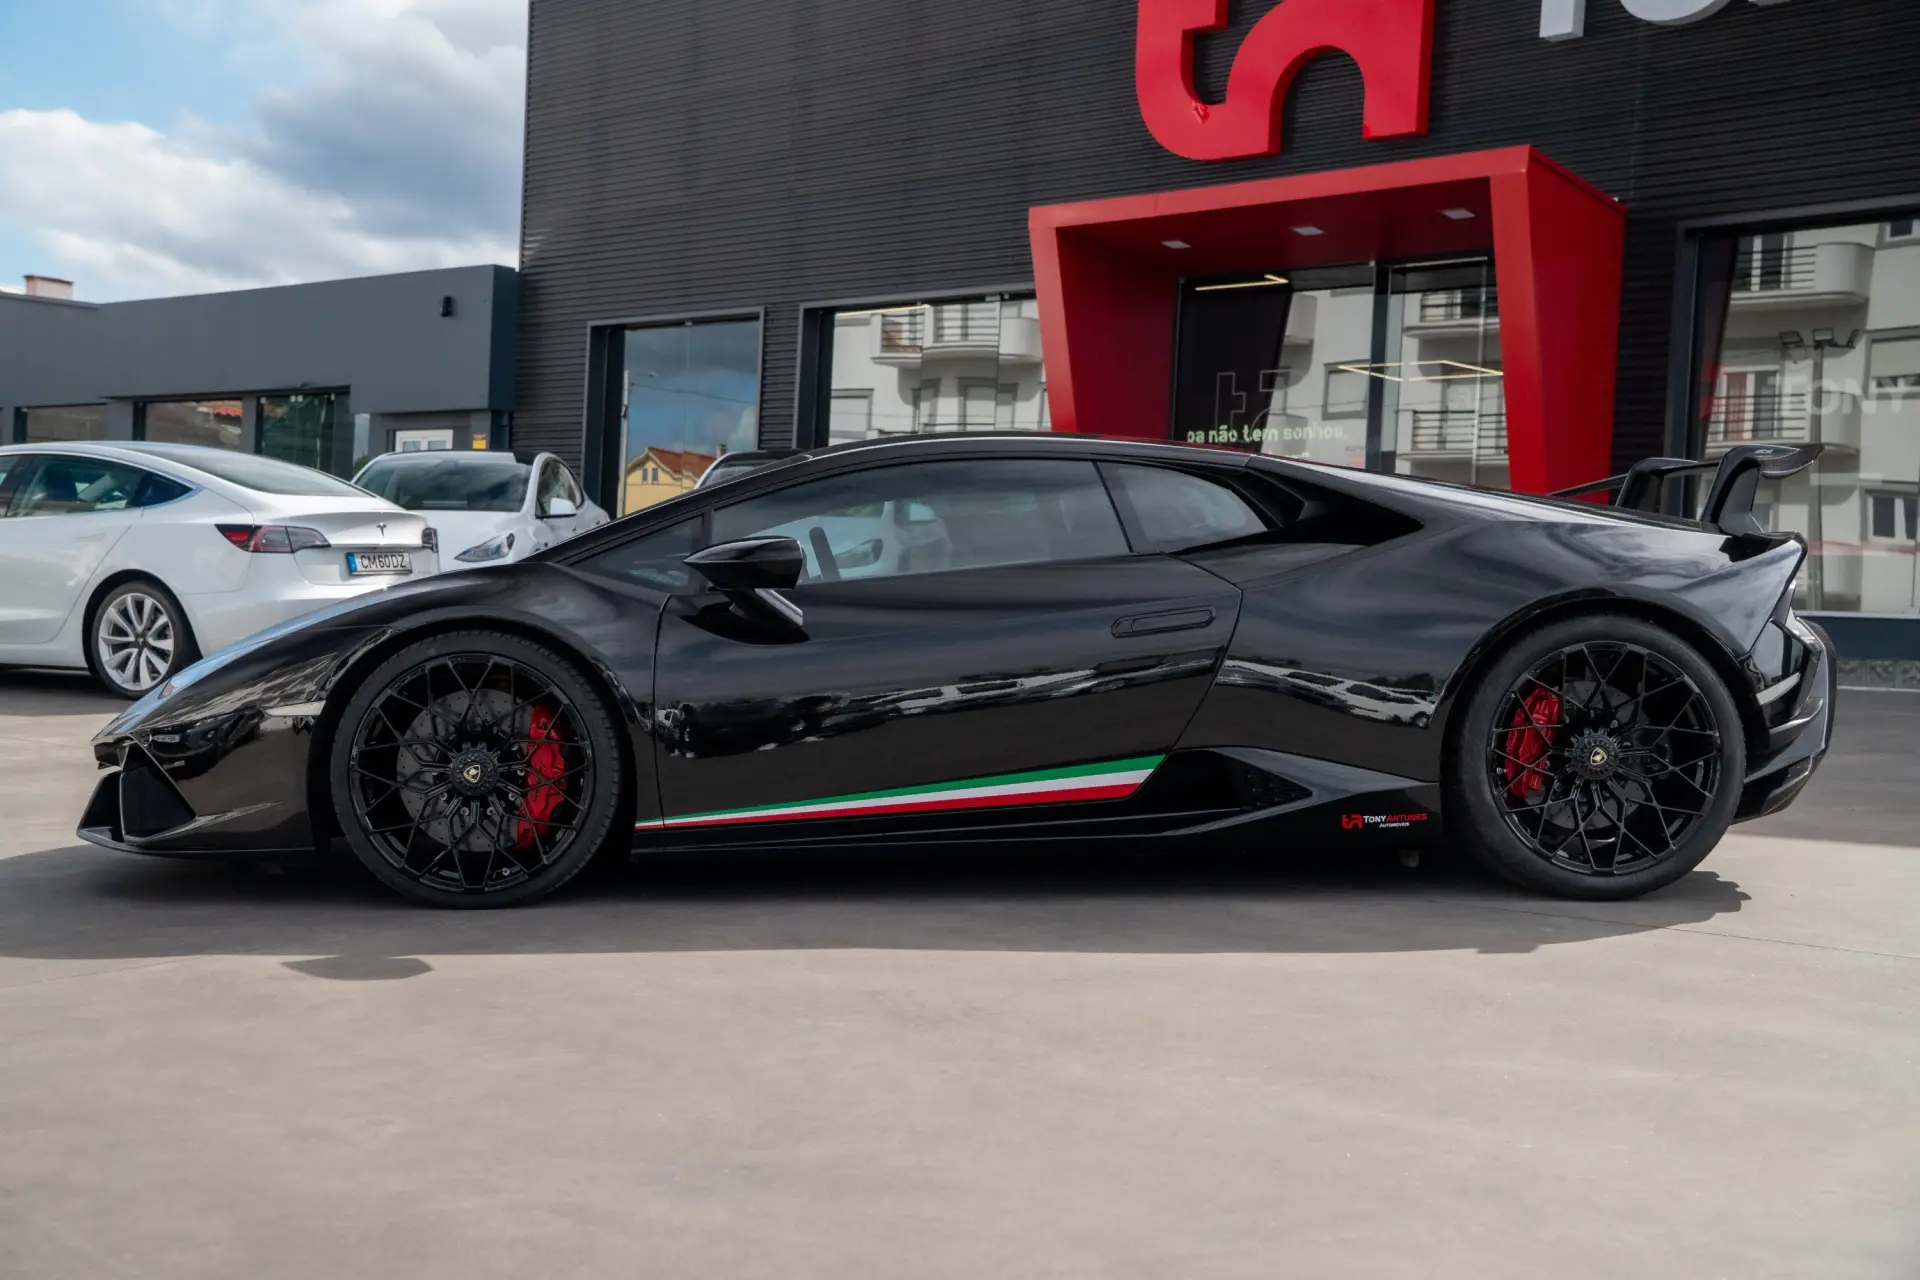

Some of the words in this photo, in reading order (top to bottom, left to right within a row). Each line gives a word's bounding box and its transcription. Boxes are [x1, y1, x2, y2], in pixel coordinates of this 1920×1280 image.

[1208, 424, 1239, 443] não
[1243, 424, 1278, 442] tem
[360, 554, 407, 569] CM60DZ
[1363, 815, 1387, 823] TONY
